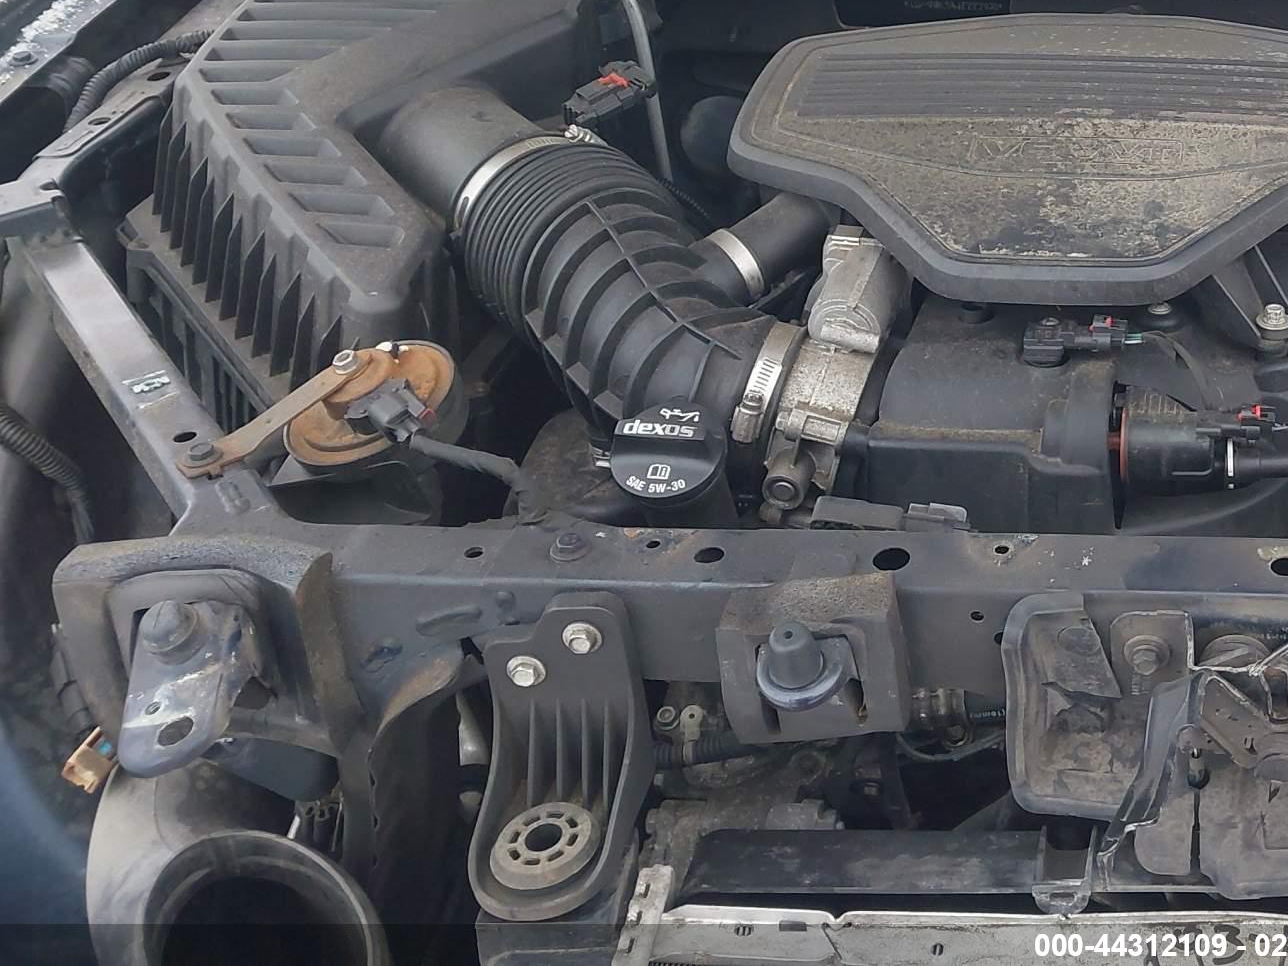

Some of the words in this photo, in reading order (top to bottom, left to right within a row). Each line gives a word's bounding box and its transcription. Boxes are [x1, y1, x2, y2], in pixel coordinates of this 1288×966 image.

[622, 419, 699, 438] dexos
[625, 475, 647, 492] SAE
[647, 478, 686, 494] 5W-30
